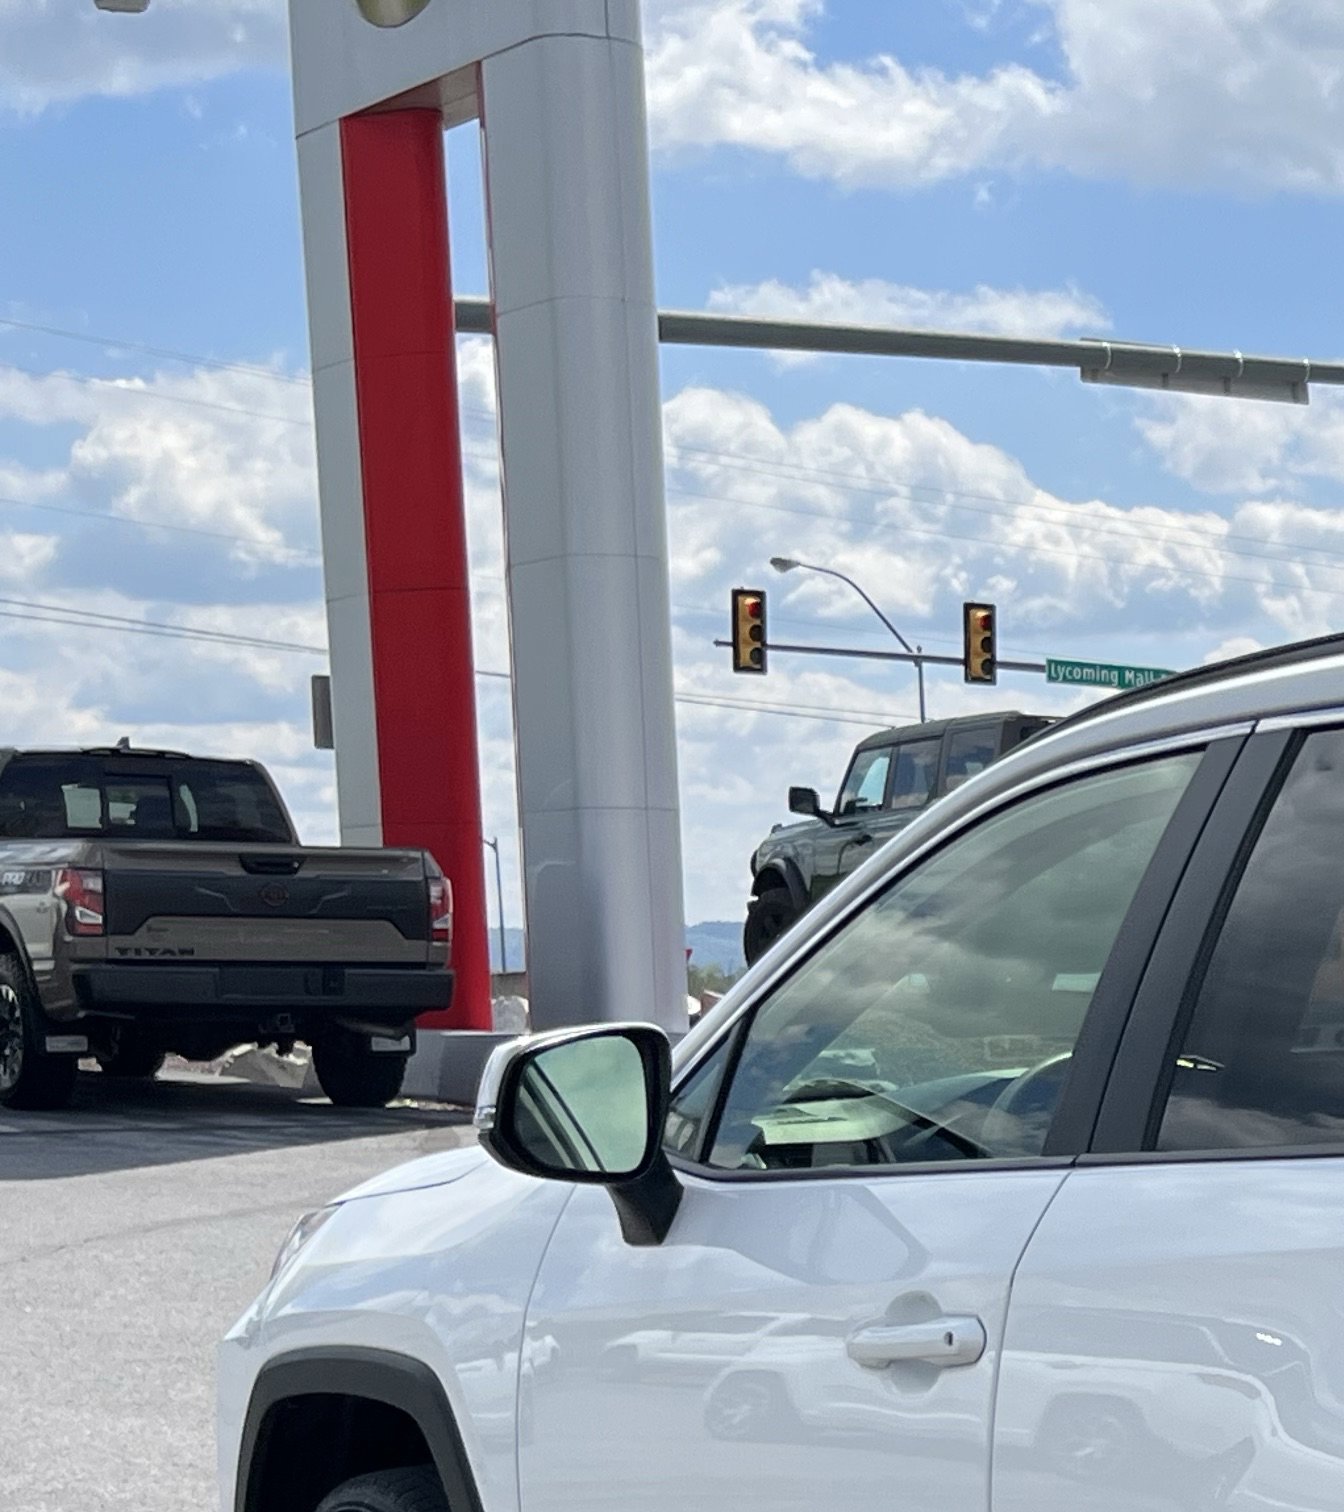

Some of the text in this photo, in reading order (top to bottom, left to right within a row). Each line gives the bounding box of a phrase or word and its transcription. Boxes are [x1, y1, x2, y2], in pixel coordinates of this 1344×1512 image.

[1050, 662, 1119, 687] Lycoming
[1124, 669, 1156, 687] Mall
[115, 946, 196, 957] TITAN
